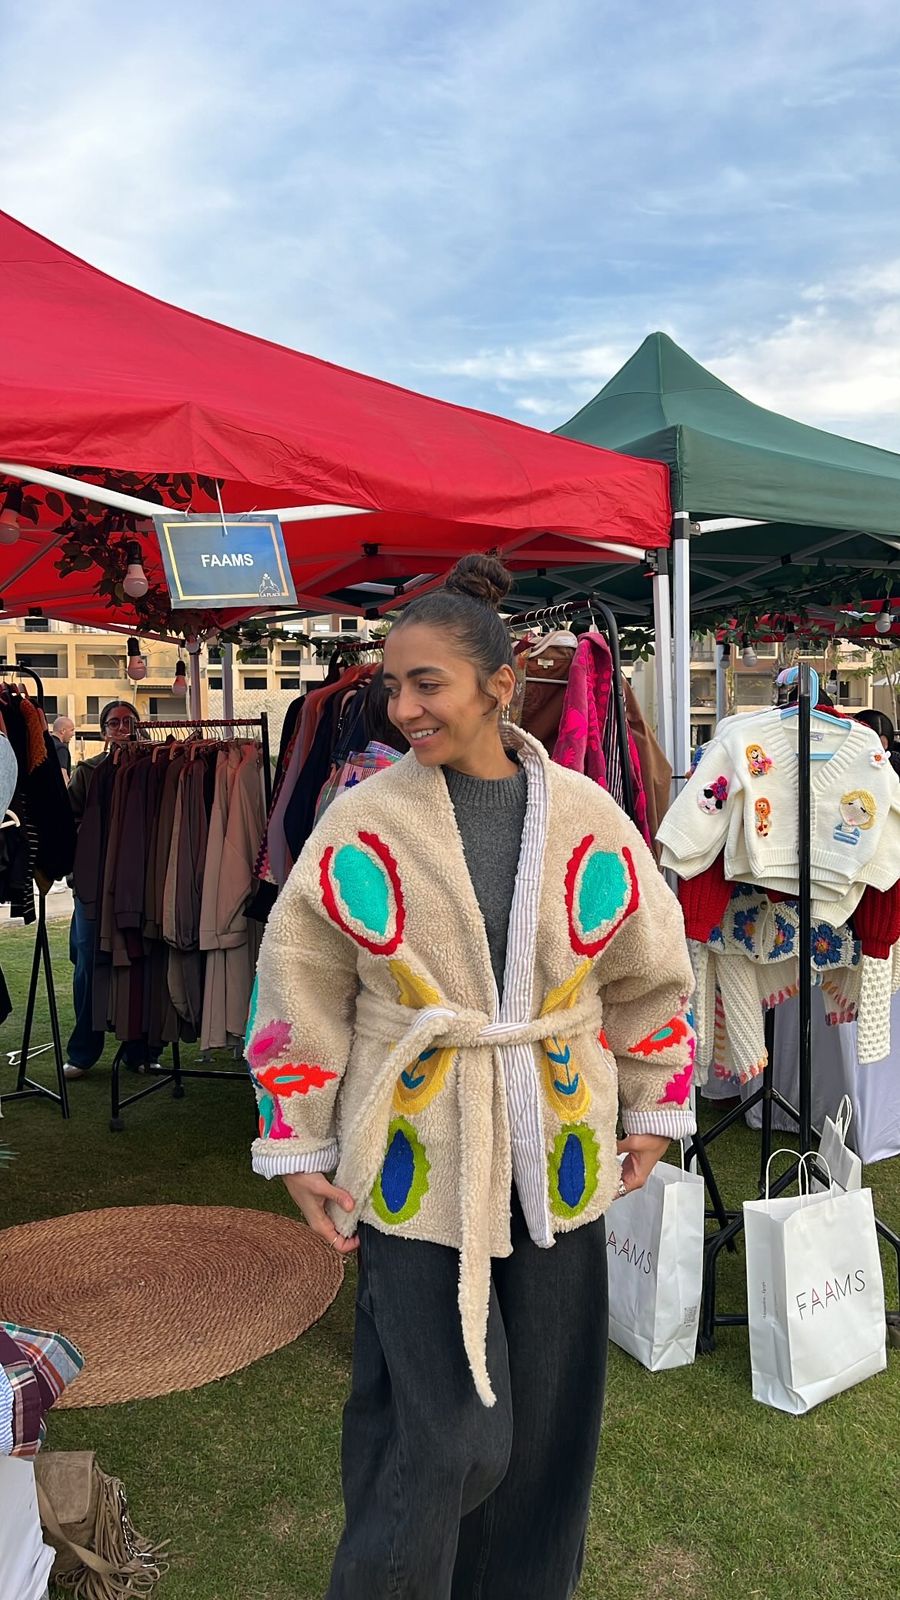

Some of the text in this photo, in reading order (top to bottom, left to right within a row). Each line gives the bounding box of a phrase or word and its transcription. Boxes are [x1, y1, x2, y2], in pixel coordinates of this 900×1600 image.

[201, 553, 254, 568] FAAMS
[605, 1230, 652, 1274] AAMS
[796, 1269, 866, 1321] FAAMS
